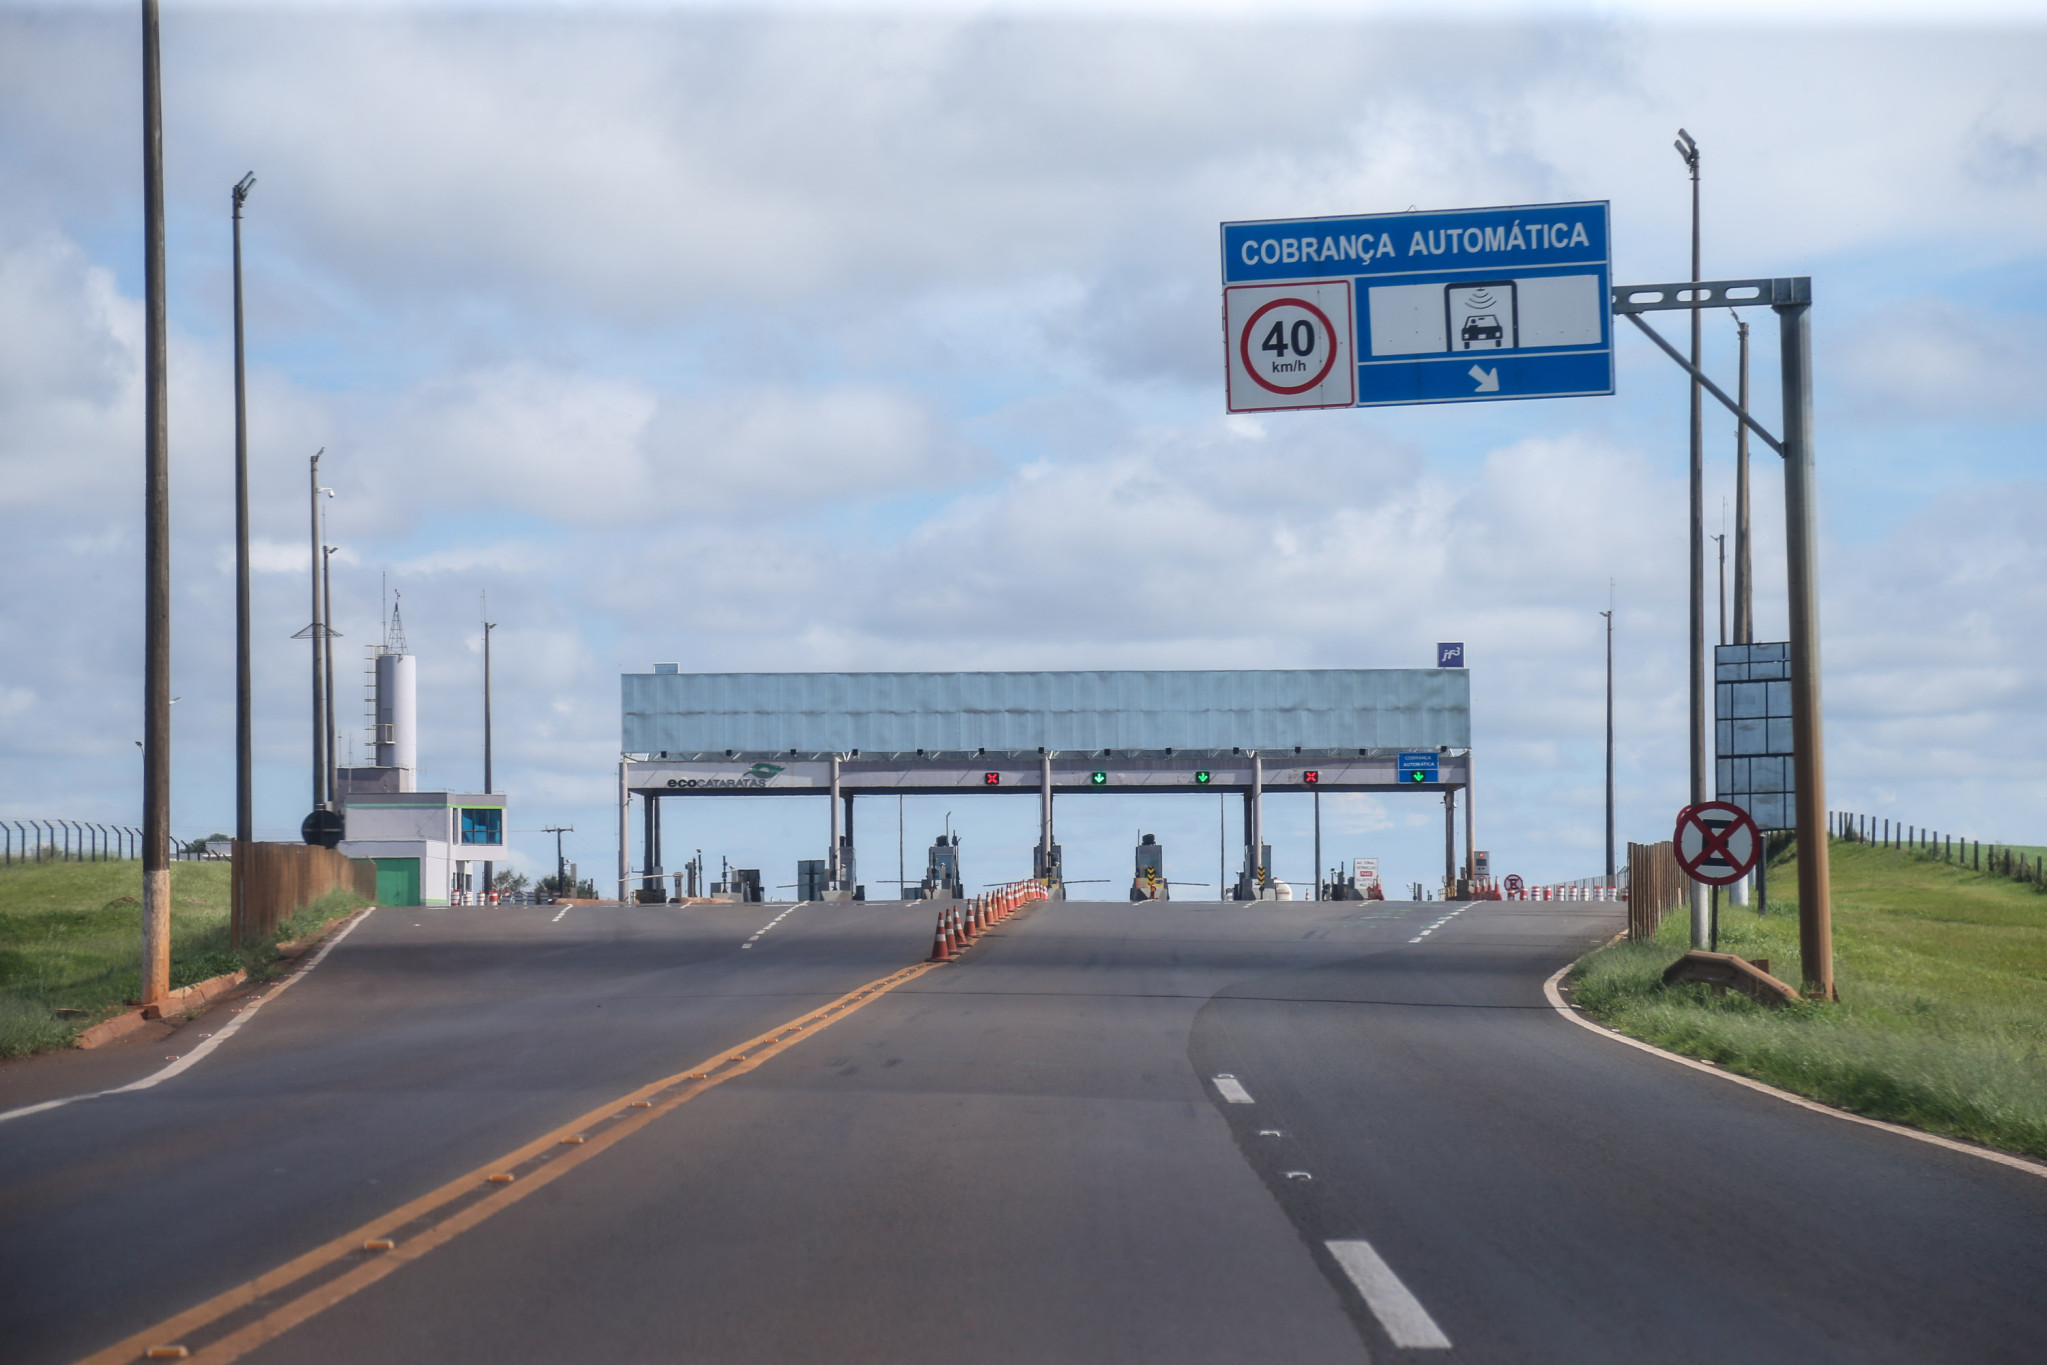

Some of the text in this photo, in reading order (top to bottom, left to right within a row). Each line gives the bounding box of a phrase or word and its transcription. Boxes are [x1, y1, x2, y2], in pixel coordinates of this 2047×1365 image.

[1241, 219, 1590, 266] COBRANÇA AUTOMÁTICA
[1261, 319, 1316, 358] 40
[1272, 359, 1307, 373] km/h
